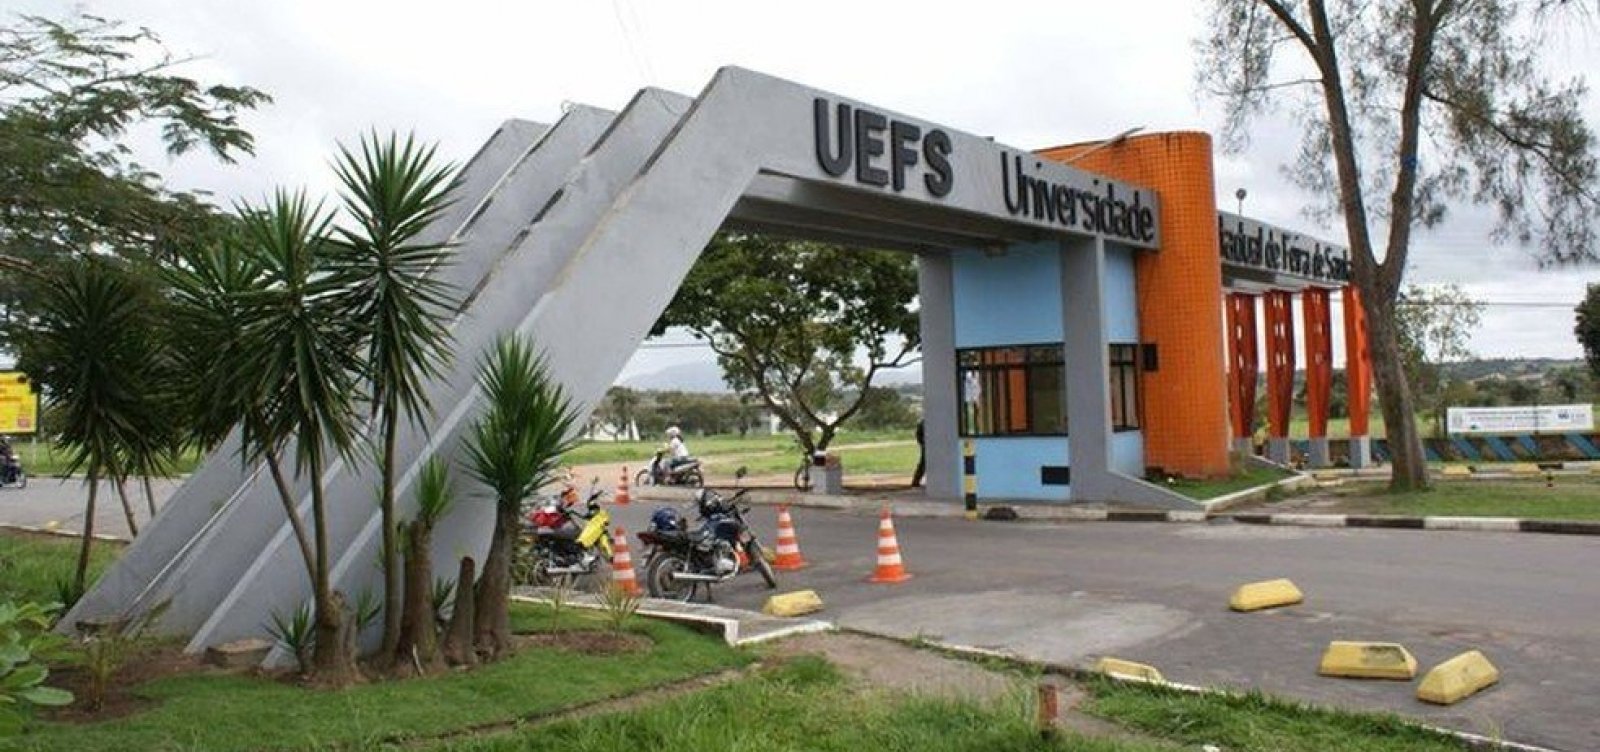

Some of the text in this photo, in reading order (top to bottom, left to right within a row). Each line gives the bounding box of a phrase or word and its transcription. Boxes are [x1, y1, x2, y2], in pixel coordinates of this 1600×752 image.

[813, 98, 1155, 242] UEFS Universidade
[1218, 214, 1263, 265] tadual
[1282, 232, 1309, 275] Feira
